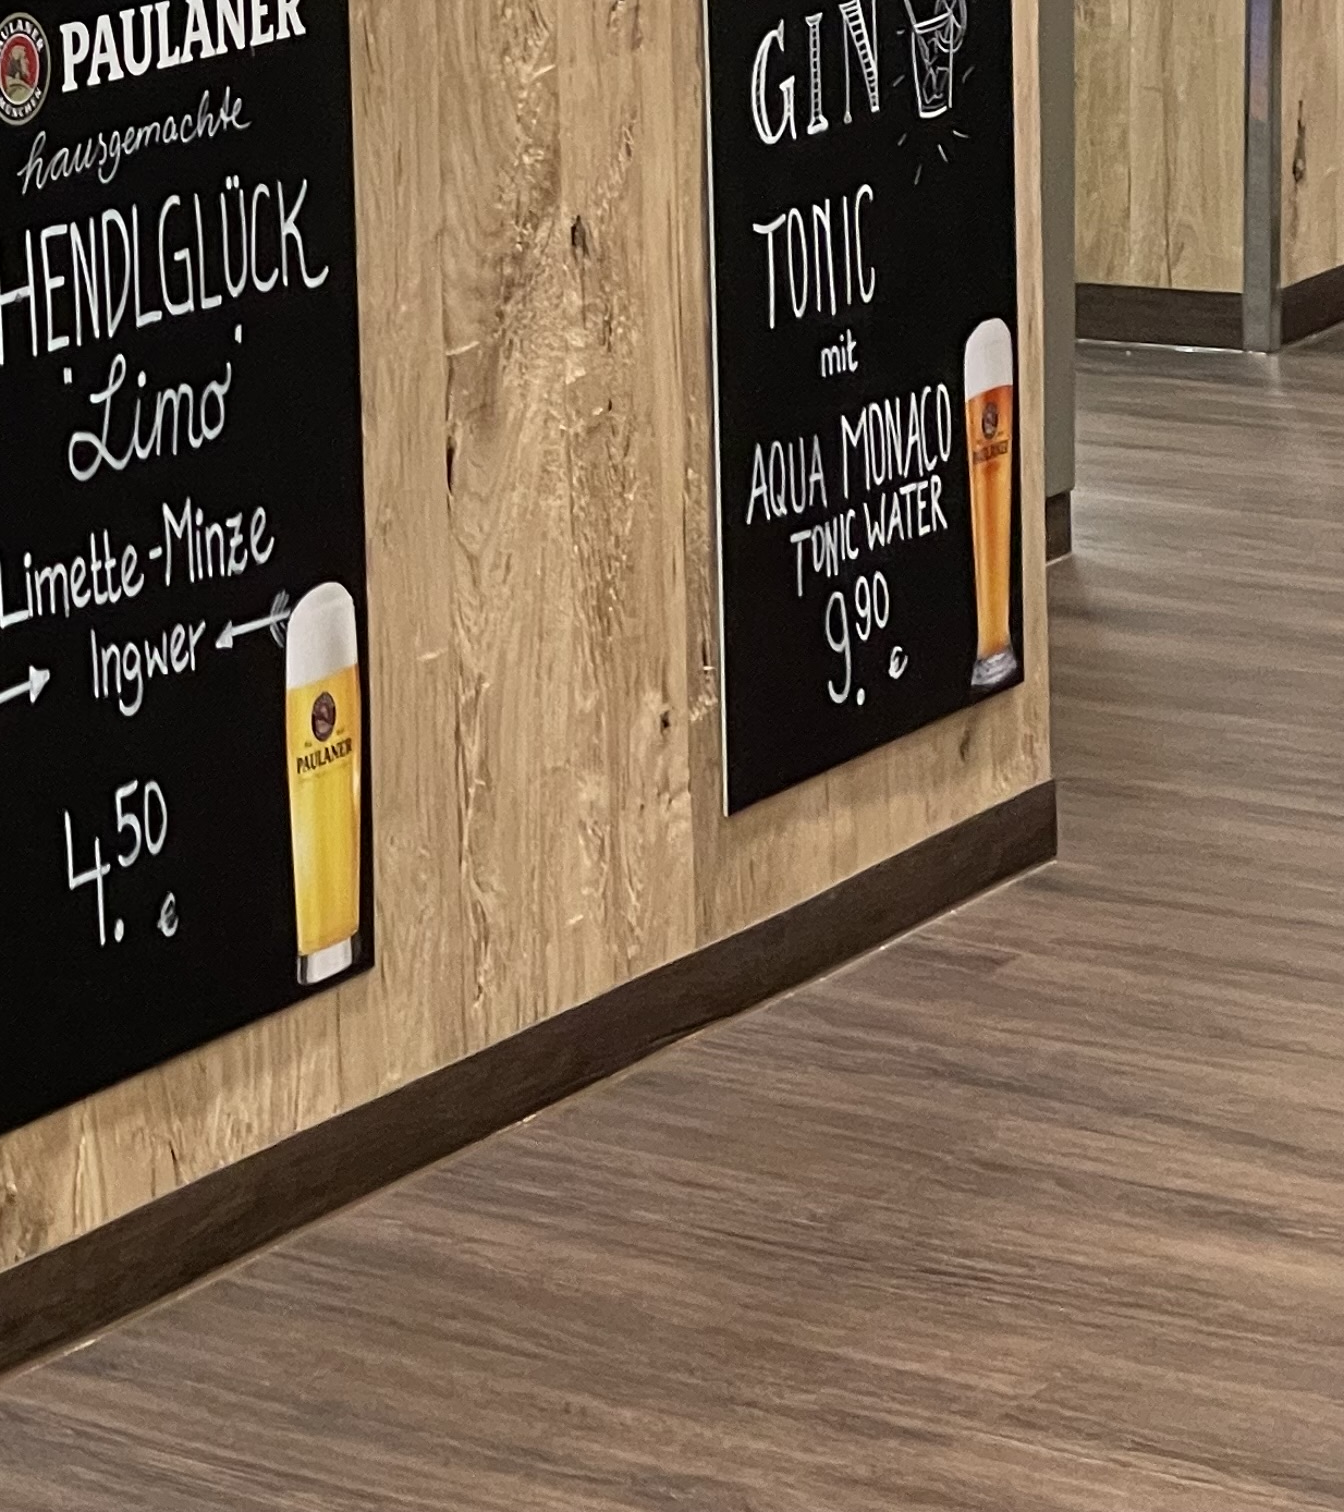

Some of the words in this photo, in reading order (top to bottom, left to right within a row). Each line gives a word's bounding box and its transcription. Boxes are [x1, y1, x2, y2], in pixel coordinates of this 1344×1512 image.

[17, 86, 252, 194] hausgemachte
[752, 184, 875, 329] TONIC
[821, 329, 858, 378] mit
[746, 434, 828, 525] AQUA
[841, 383, 952, 498] MONACO
[790, 508, 859, 597] TONIC
[863, 474, 948, 551] WATER
[91, 620, 206, 717] Ingwer
[296, 737, 352, 775] PAULANER
